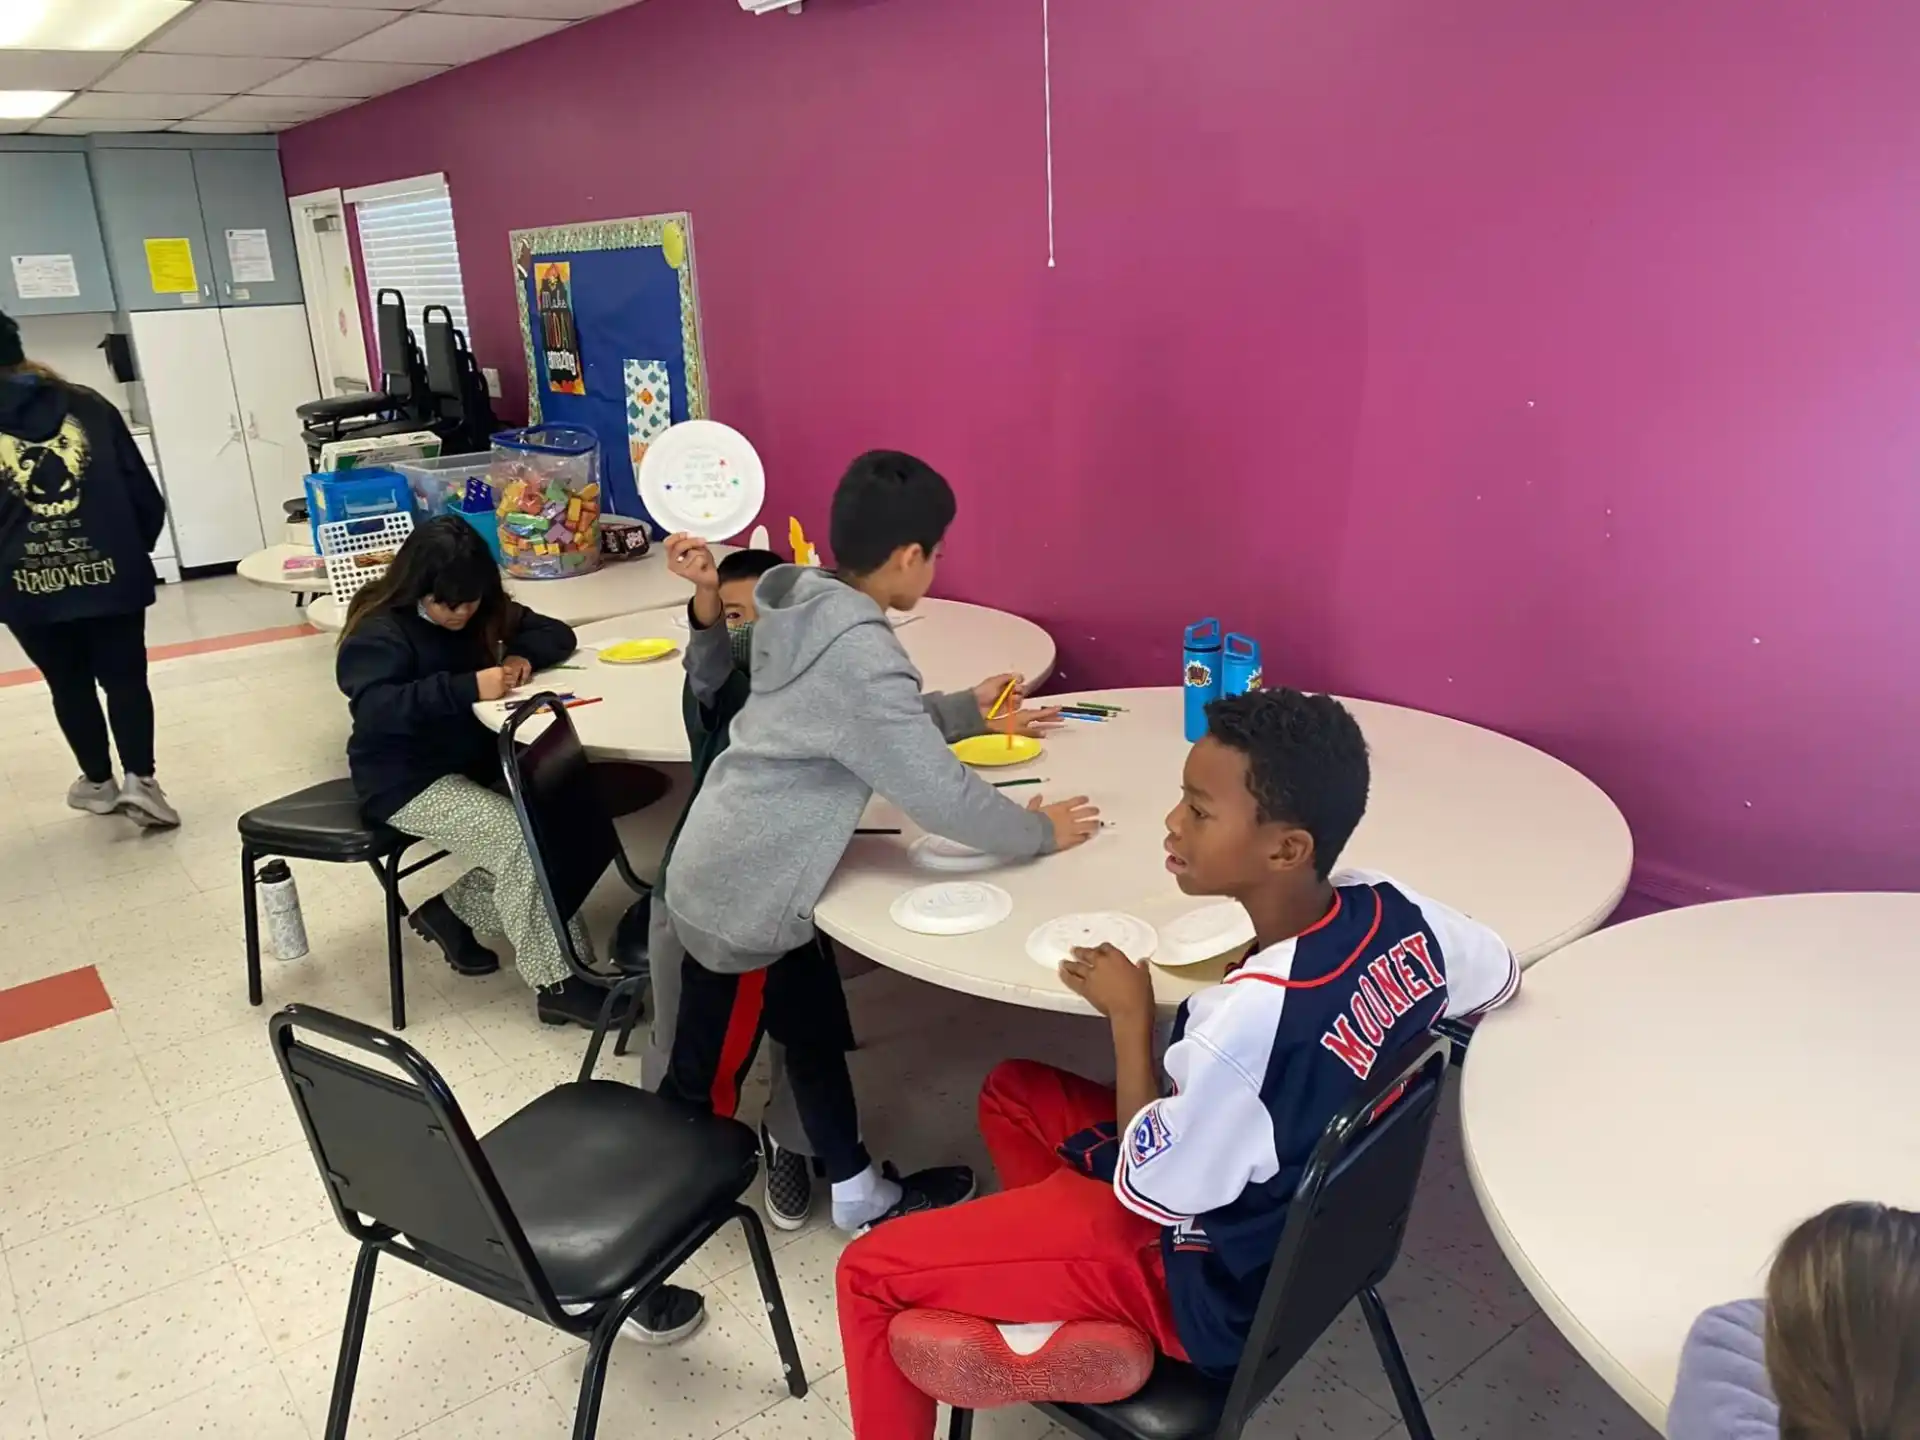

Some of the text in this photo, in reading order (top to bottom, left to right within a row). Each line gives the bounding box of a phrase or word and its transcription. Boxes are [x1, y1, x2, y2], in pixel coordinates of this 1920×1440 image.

[542, 290, 567, 309] Make
[547, 351, 576, 376] amazing
[12, 558, 116, 594] HALLOWEEN
[1320, 931, 1446, 1080] MOONEY
